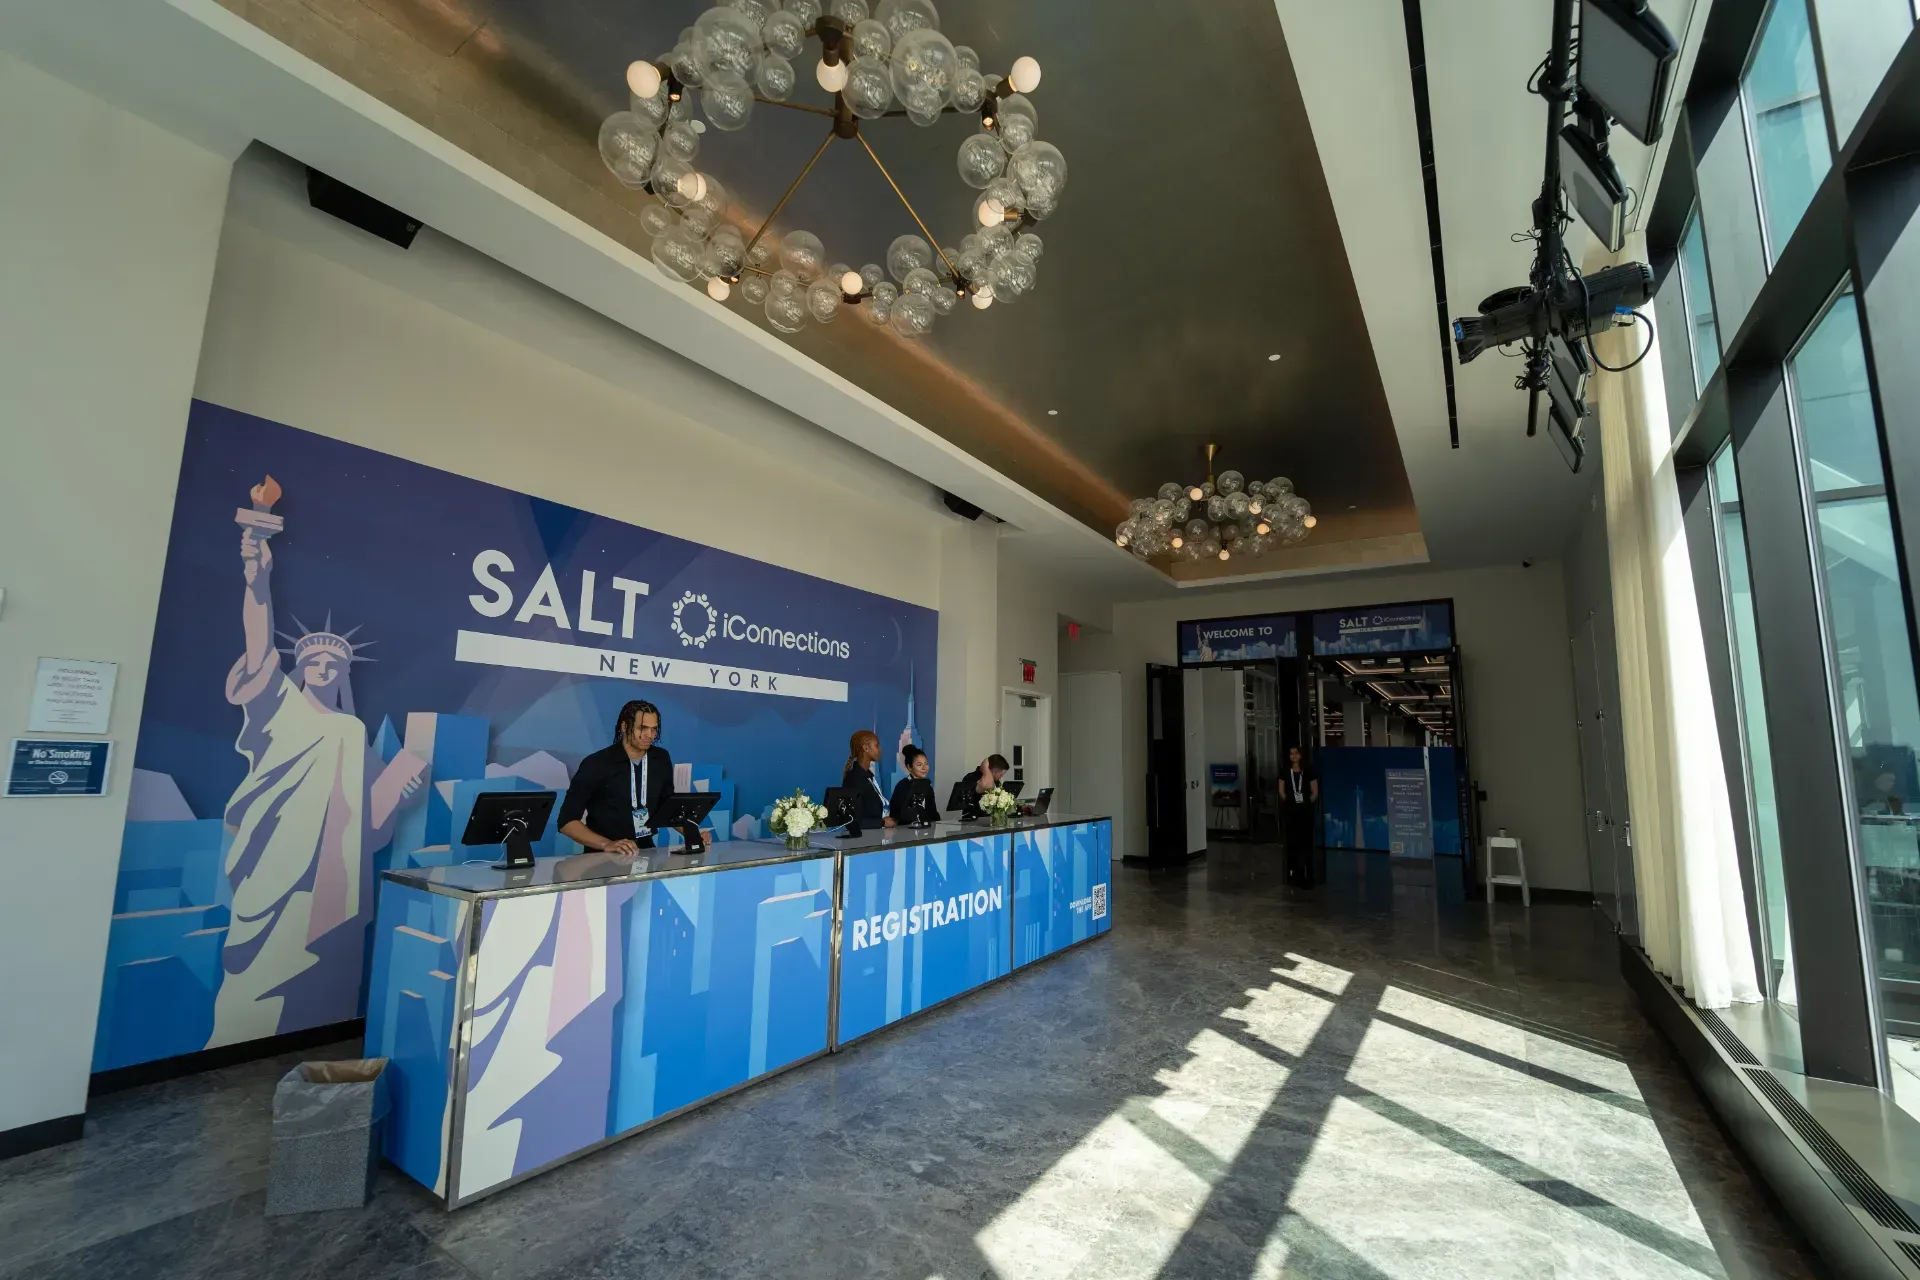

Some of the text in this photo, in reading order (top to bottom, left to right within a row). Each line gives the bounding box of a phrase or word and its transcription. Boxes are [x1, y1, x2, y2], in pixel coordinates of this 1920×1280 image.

[469, 549, 850, 660] SALT iConnections
[1339, 616, 1368, 628] SALT
[1203, 626, 1273, 639] WELCOME TO
[599, 653, 779, 692] NEW YORK
[32, 749, 91, 760] No Smoking
[1076, 905, 1084, 914] THE
[852, 885, 1002, 951] REGISTRATION
